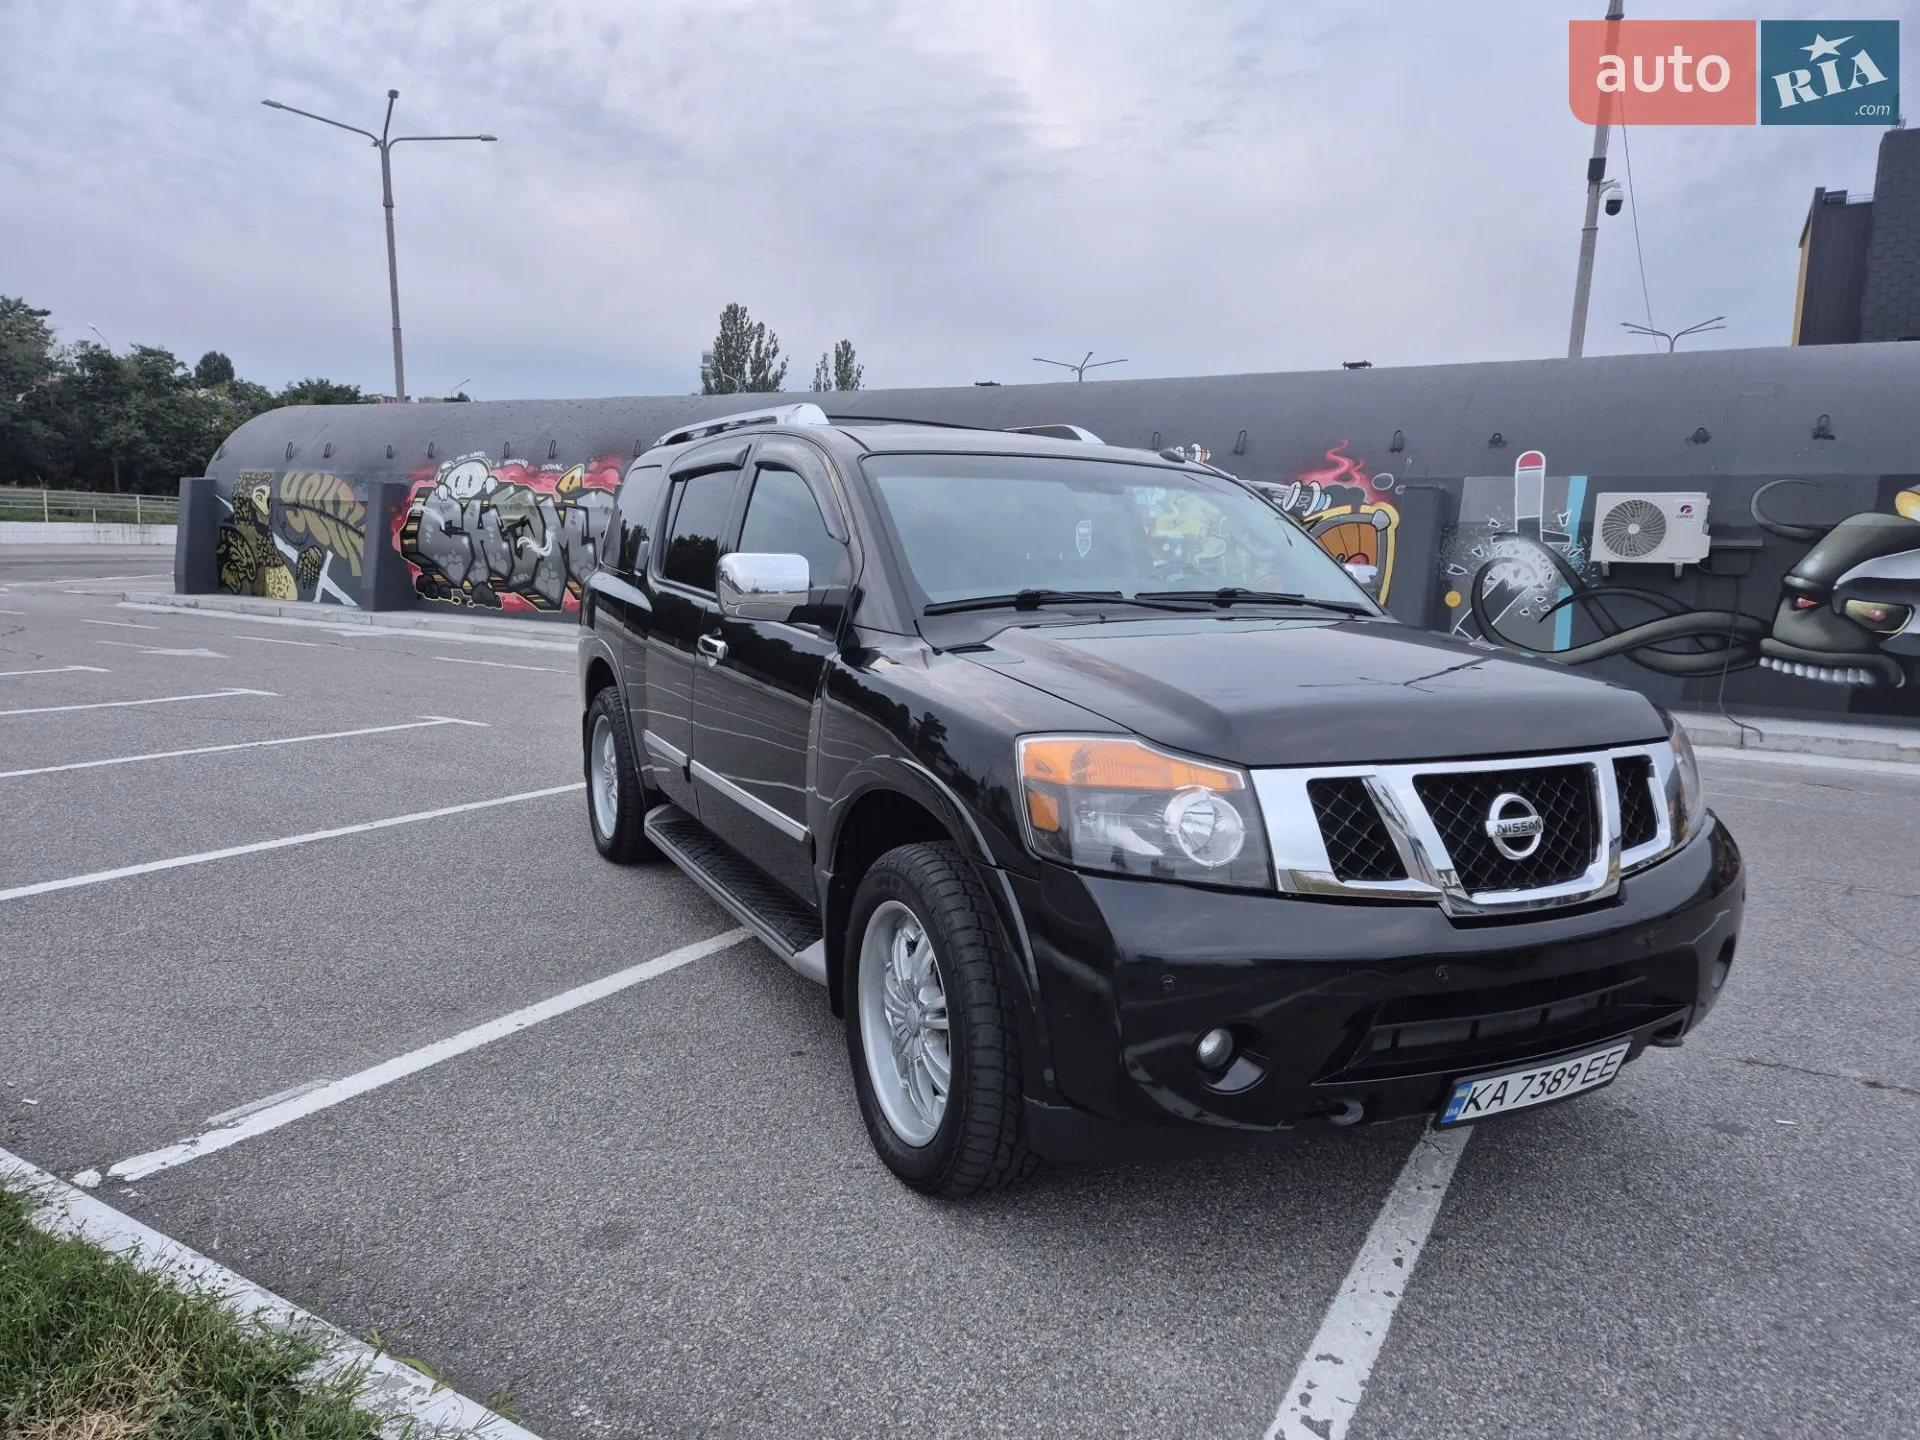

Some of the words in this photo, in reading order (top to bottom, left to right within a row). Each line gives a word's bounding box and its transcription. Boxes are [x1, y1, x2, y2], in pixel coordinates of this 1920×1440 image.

[1497, 820, 1541, 833] NISSAN
[1463, 1080, 1508, 1113] KA
[1512, 1063, 1582, 1103] 7389
[1582, 1049, 1624, 1084] EE
